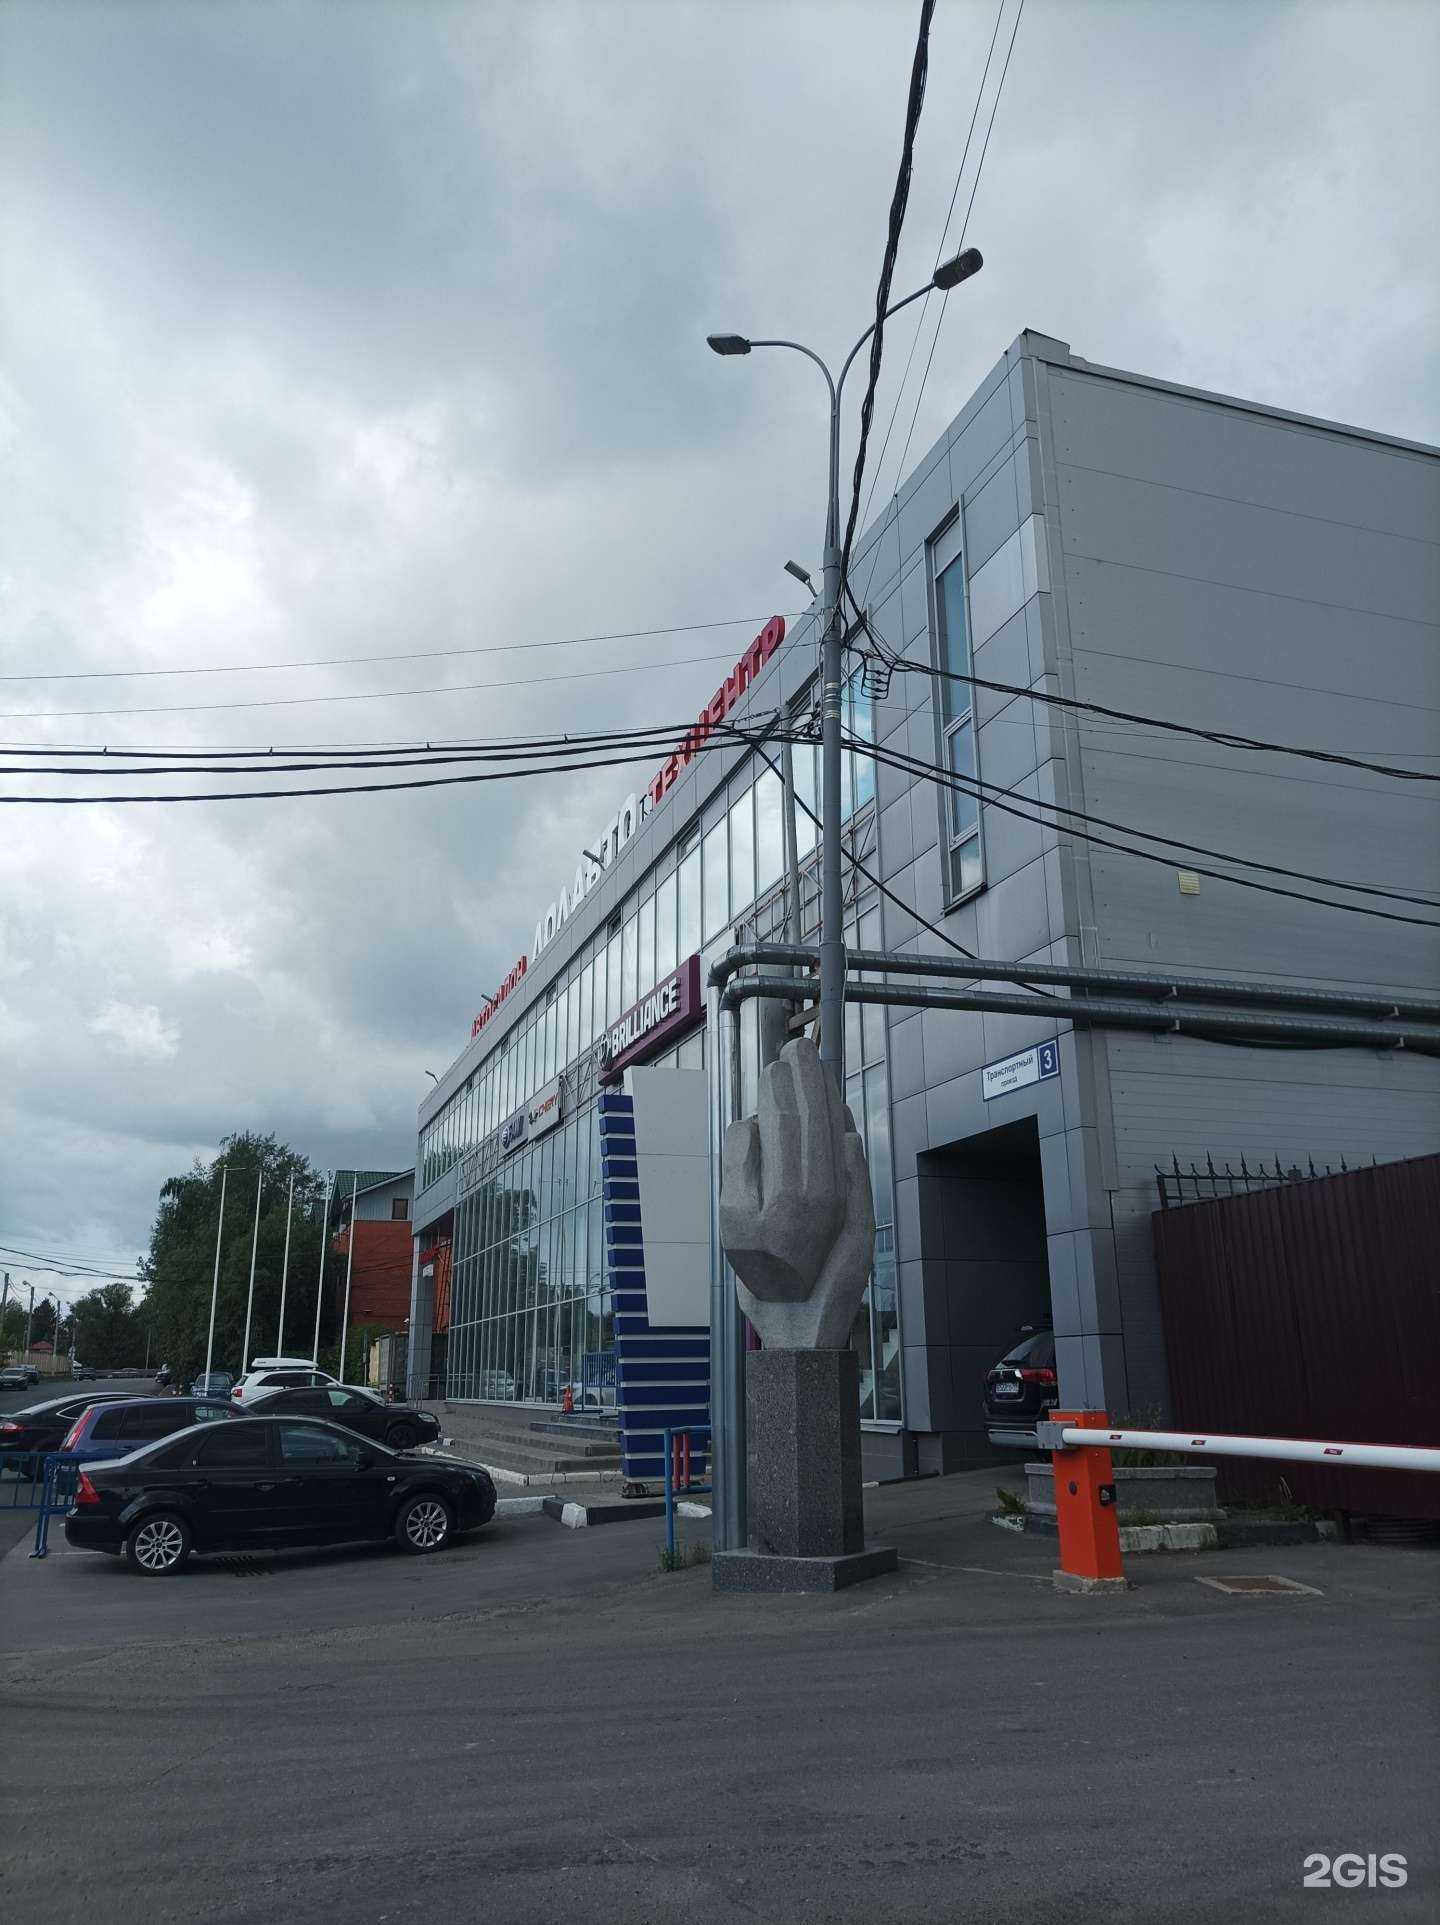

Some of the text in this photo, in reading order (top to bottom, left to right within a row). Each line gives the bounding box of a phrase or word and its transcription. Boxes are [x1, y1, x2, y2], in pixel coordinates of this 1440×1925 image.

[612, 977, 679, 1058] BRILLIANCE
[986, 1049, 1053, 1082] Транспортный 3
